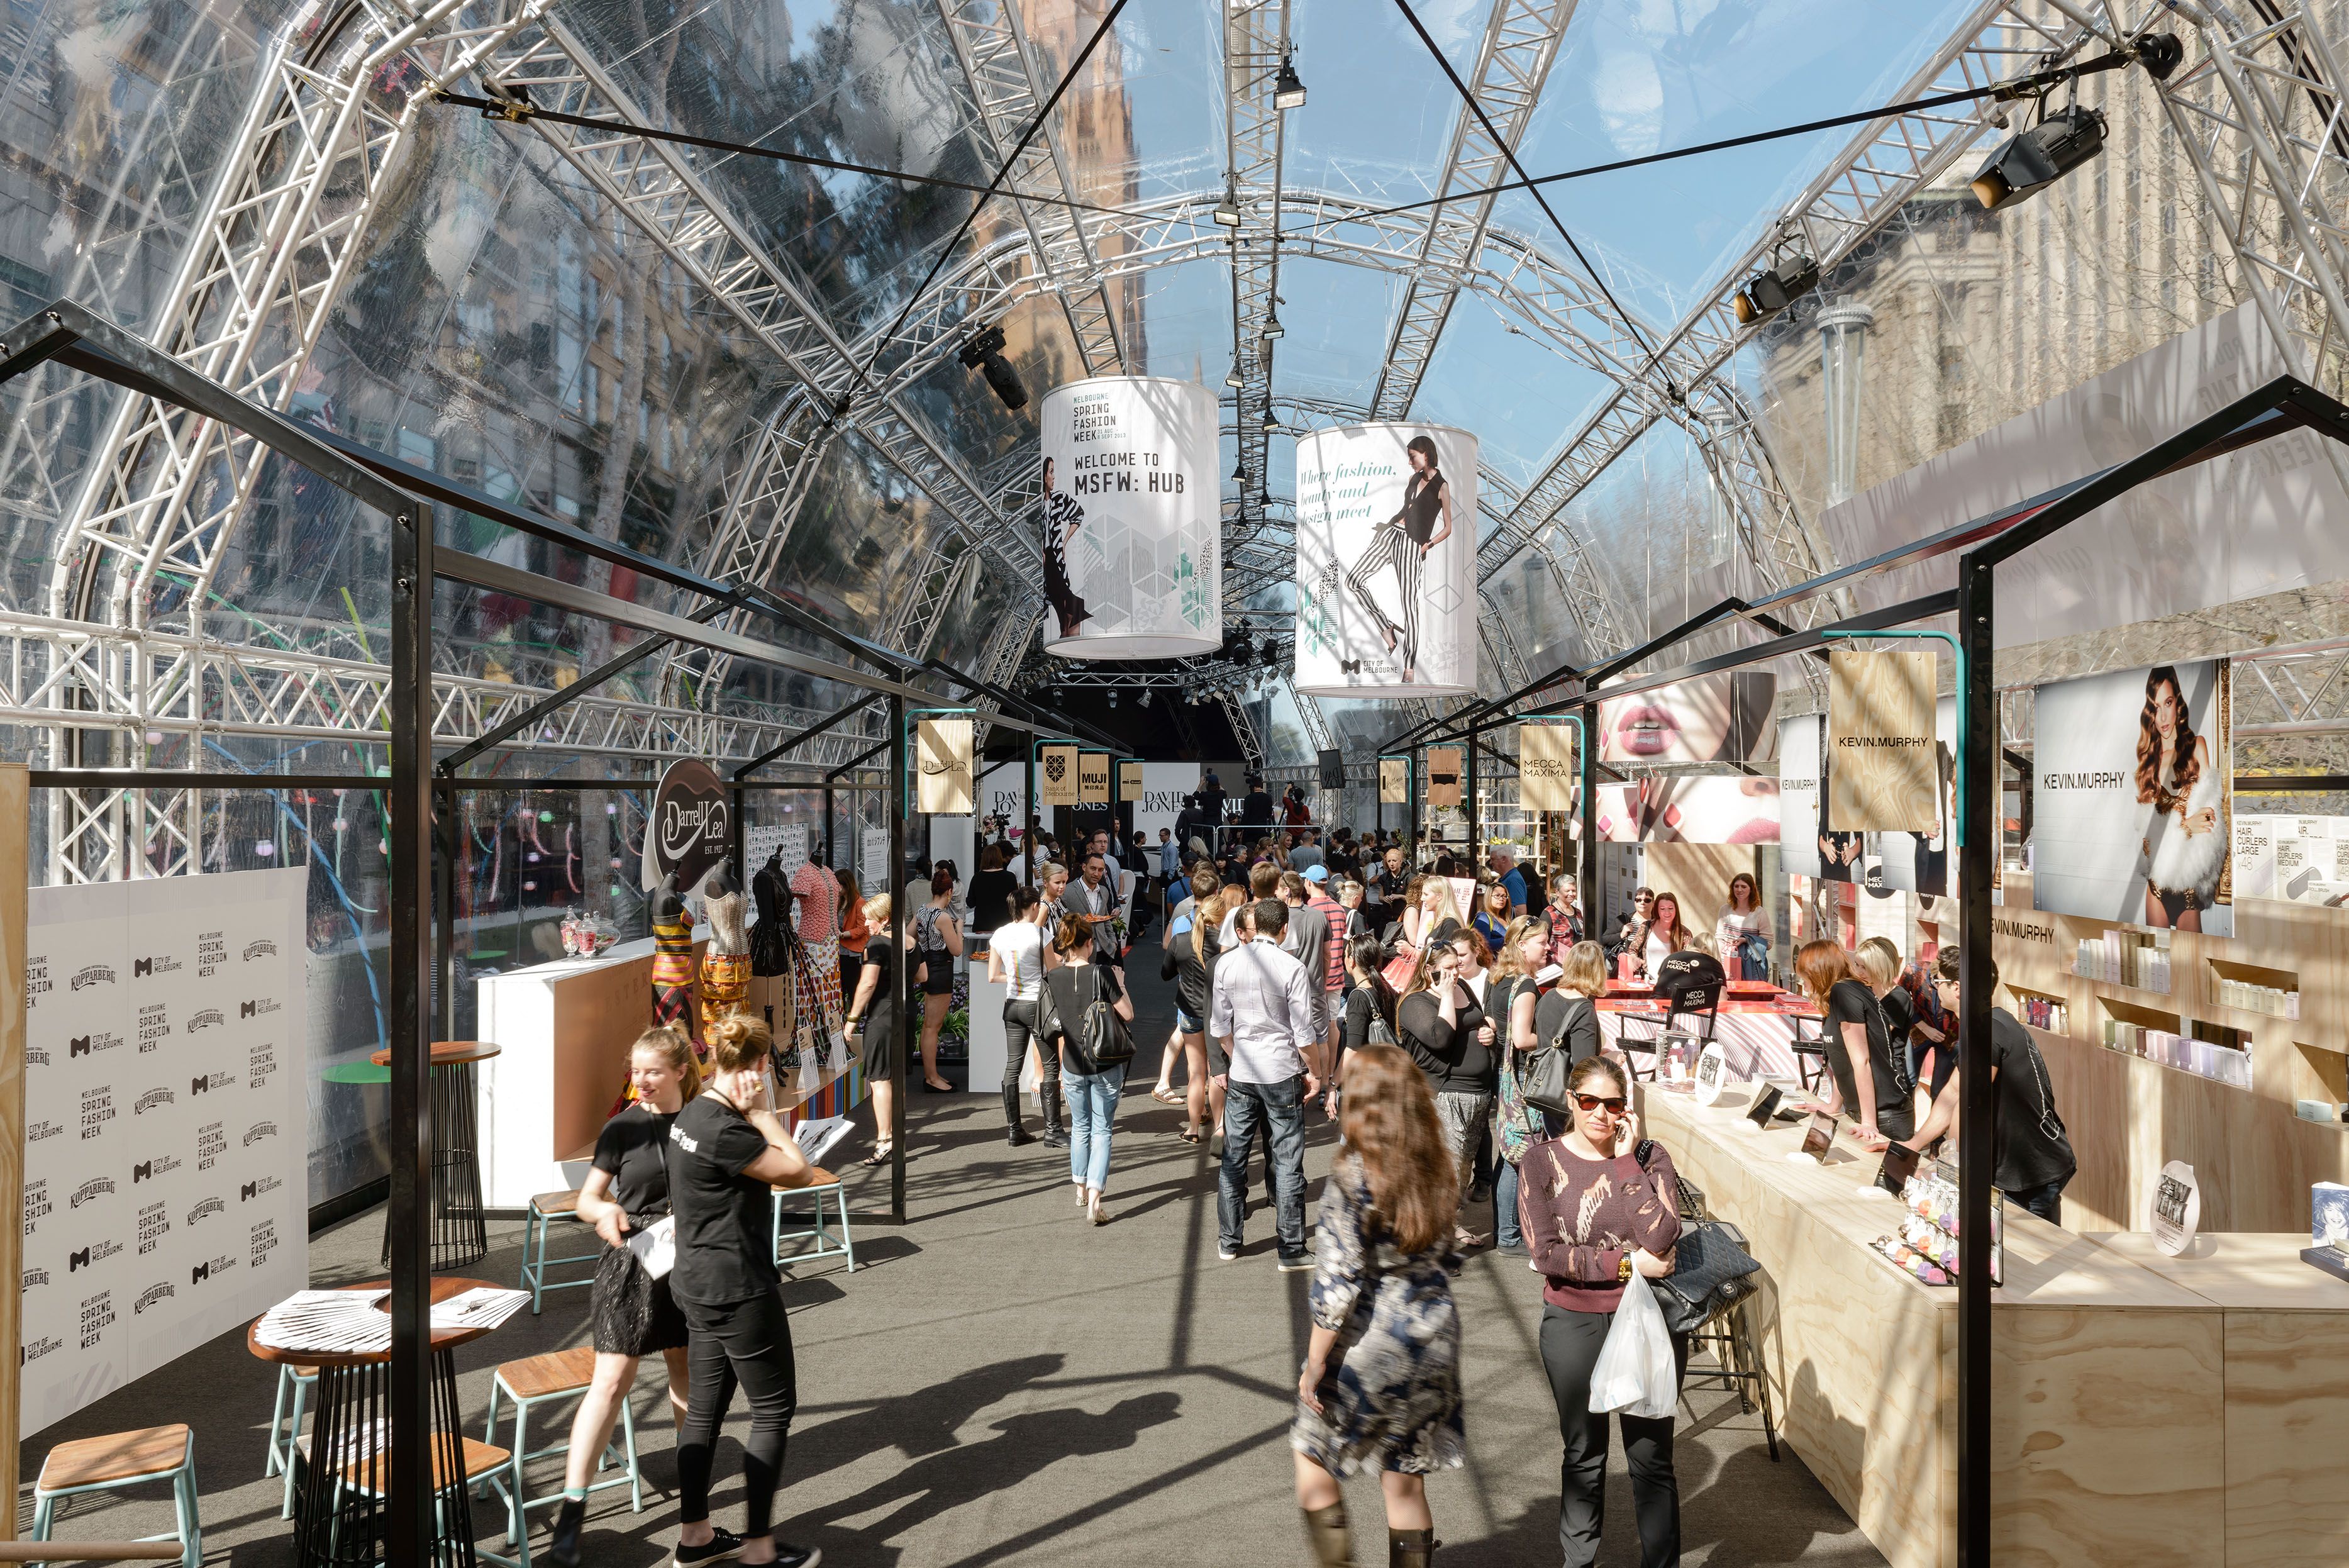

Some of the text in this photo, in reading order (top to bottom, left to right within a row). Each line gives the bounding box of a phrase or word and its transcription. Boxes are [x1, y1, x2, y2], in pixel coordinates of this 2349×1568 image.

[1074, 392, 1109, 403] MELBOURNE
[1074, 403, 1109, 417] SPRING
[1074, 416, 1116, 430] FASHION
[1074, 430, 1097, 443] WEEK
[1075, 453, 1158, 470] WELCOME TO
[1301, 462, 1397, 486] Where fashion,
[1075, 472, 1184, 496] MSFW: HUB
[1301, 482, 1369, 506] beauty and
[1301, 505, 1372, 526] design meet
[1839, 737, 1928, 747] KEVIN.MURPHY
[925, 760, 965, 772] Darrell Lea
[1524, 759, 1563, 768] MECCA
[1082, 774, 1106, 784] MUJI
[1524, 769, 1567, 777] MAXIMA
[2044, 771, 2125, 790] KEVIN.MURPHY
[1782, 779, 1817, 791] KEVIN.MURPHY
[1145, 791, 1187, 803] DAVID
[666, 801, 724, 842] Darrell Lea
[2236, 827, 2253, 836] HAIR.
[705, 845, 723, 854] EST. 1927
[2236, 837, 2268, 847] CURLERS
[2236, 846, 2259, 855] LARGE
[199, 931, 223, 940] MELBOURNE
[1992, 918, 2055, 945] EVIN.MURPHY
[199, 941, 223, 953] SPRING
[243, 943, 277, 962] KOPPARBERG
[26, 956, 47, 967] OURNE
[199, 952, 226, 965] FASHION
[1667, 960, 1691, 968] MECCA
[26, 967, 47, 981] RING
[155, 962, 182, 973] MELBOURNE
[199, 966, 214, 977] WEEK
[1666, 964, 1691, 974] MAXIMA
[70, 969, 116, 991] KOPPARBERG
[26, 980, 52, 996] SHION
[1686, 991, 1705, 999] MECCA
[26, 996, 36, 1008] EK
[140, 1003, 165, 1015] MELBOURNE
[258, 1003, 280, 1014] MELBOURNE
[1684, 998, 1705, 1007] MAXIMA
[140, 1013, 165, 1028] SPRING
[187, 1012, 225, 1033] KOPPARBERG
[93, 1034, 103, 1043] CITY
[140, 1025, 170, 1041] FASHION
[93, 1038, 123, 1052] MELBOURNE
[139, 1040, 157, 1054] WEEK
[250, 1043, 272, 1054] MELBOURNE
[26, 1052, 49, 1065] RBERG
[250, 1052, 272, 1066] SPRING
[250, 1062, 276, 1077] FASHION
[210, 1076, 235, 1089] MELBOURNE
[211, 1074, 219, 1082] CITY
[250, 1077, 265, 1089] WEEK
[82, 1085, 111, 1099] MELBOURNE
[82, 1096, 111, 1113] SPRING
[135, 1091, 174, 1115] KOPPARBERG
[82, 1108, 116, 1126] FASHION
[30, 1121, 49, 1133] CITY OF
[30, 1125, 63, 1142] MELBOURNE
[82, 1125, 101, 1140] WEEK
[199, 1121, 223, 1134] MELBOURNE
[199, 1130, 223, 1147] SPRING
[243, 1124, 277, 1147] KOPPARBERG
[199, 1141, 226, 1159] FASHION
[154, 1158, 163, 1167] CITY
[154, 1159, 181, 1175] MELBOURNE
[199, 1157, 214, 1171] WEEK
[25, 1179, 47, 1192] BOURNE
[258, 1179, 282, 1194] MELBOURNE
[25, 1190, 47, 1206] RING
[70, 1181, 114, 1209] KOPPARBERG
[25, 1202, 52, 1221] SHION
[139, 1201, 165, 1216] MELBOURNE
[187, 1199, 225, 1226] KOPPARBERG
[25, 1221, 35, 1235] EK
[139, 1211, 165, 1230] SPRING
[252, 1218, 273, 1233] MELBOURNE
[2158, 1215, 2184, 1233] EXPERIENCE
[139, 1221, 169, 1243] FASHION
[252, 1227, 274, 1245] SPRING
[92, 1240, 111, 1254] CITY OF
[92, 1243, 123, 1262] MELBOURNE
[139, 1239, 156, 1255] WEEK
[252, 1237, 277, 1257] FASHION
[211, 1255, 226, 1269] CITY OF
[211, 1258, 236, 1276] MELBOURNE
[252, 1253, 267, 1268] WEEK
[23, 1272, 49, 1287] RBERG
[81, 1289, 110, 1309] MELBOURNE
[135, 1284, 175, 1315] KOPPARBERG
[81, 1300, 110, 1323] SPRING
[81, 1311, 115, 1337] FASHION
[28, 1337, 48, 1353] CITY OF
[81, 1331, 101, 1350] WEEK
[28, 1338, 62, 1362] MELBOURNE
